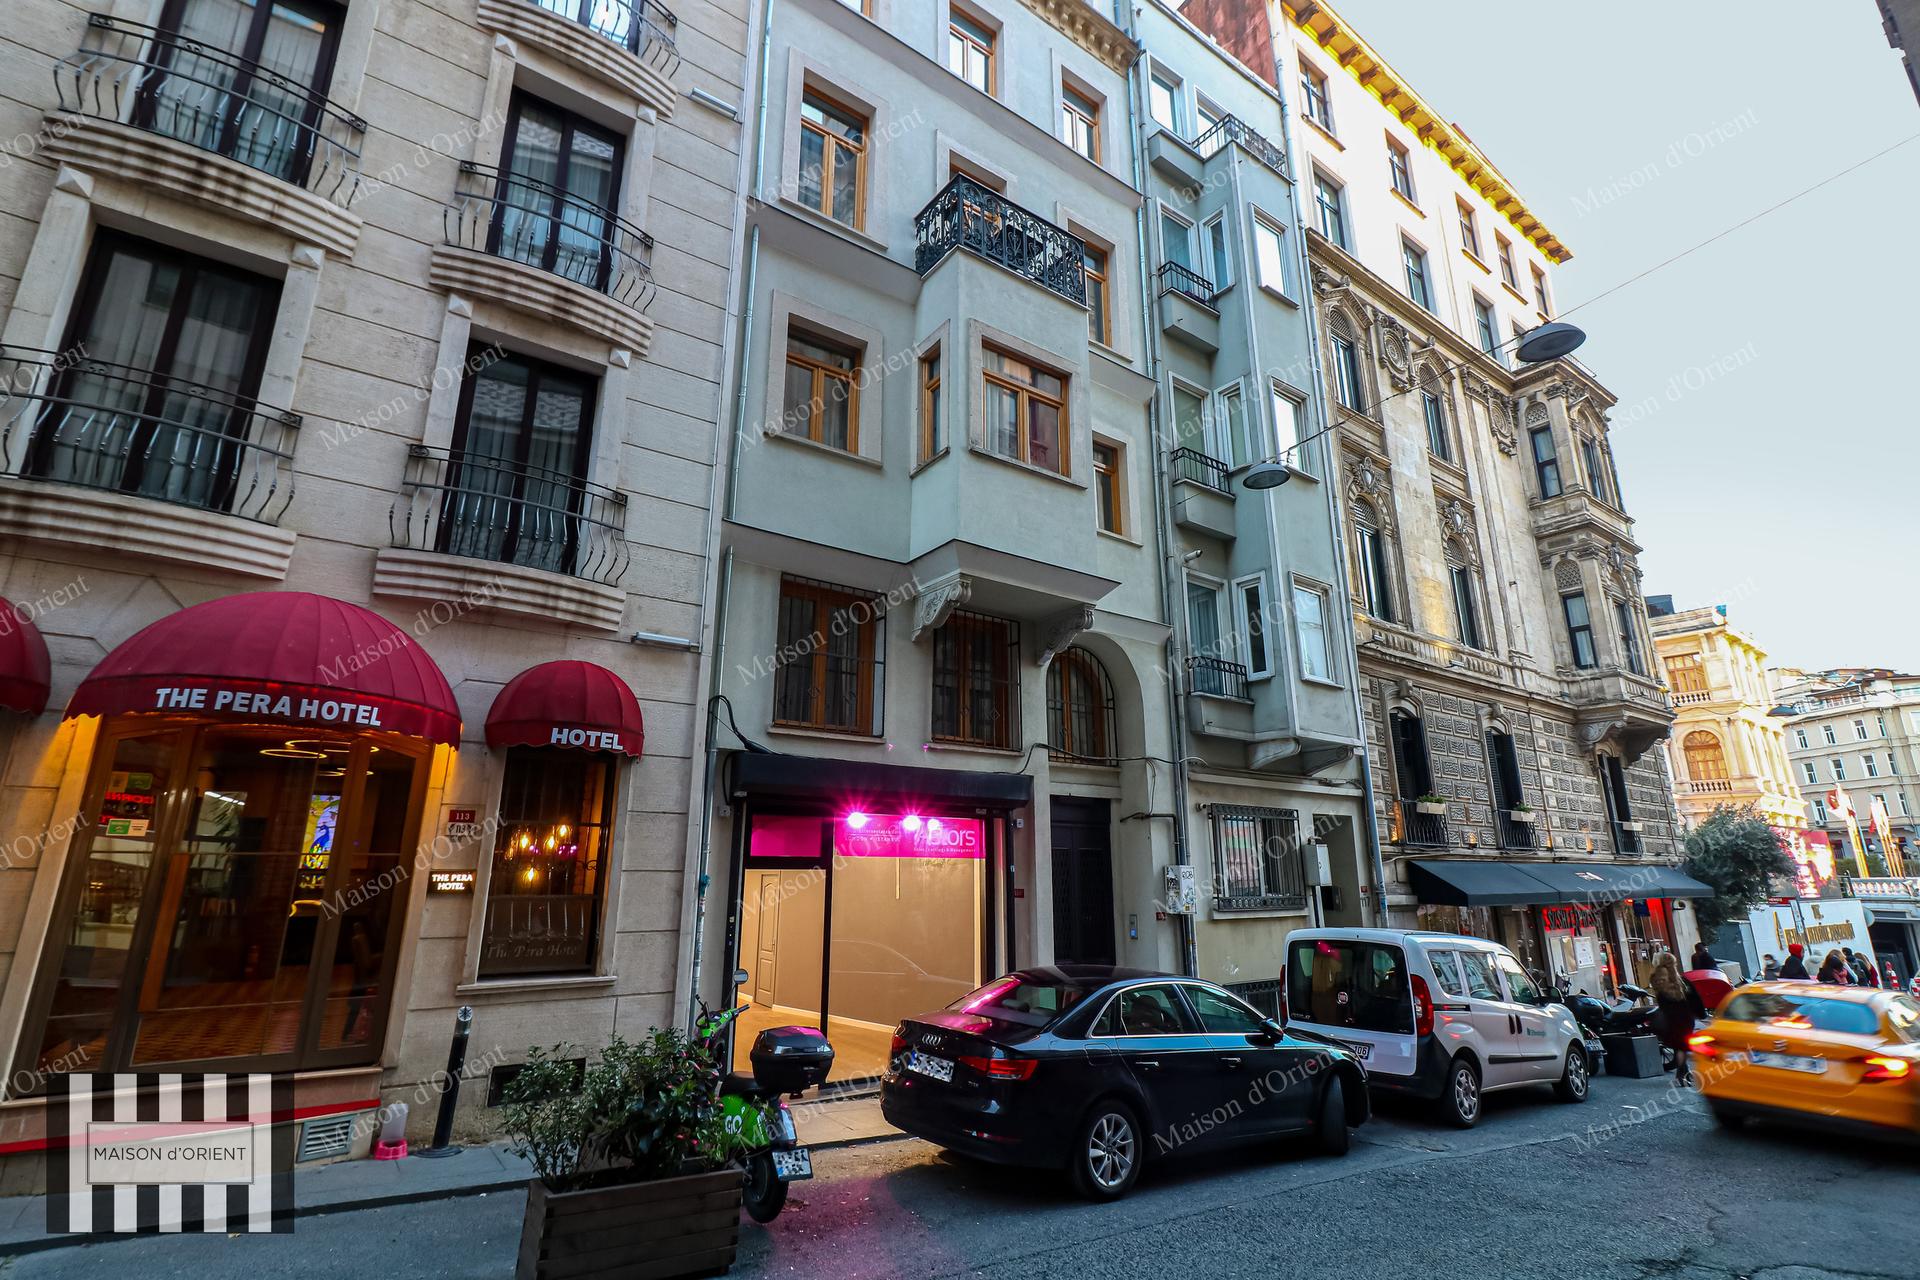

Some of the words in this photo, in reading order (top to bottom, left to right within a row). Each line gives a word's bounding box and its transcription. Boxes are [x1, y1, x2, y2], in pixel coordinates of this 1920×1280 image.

[156, 688, 207, 710] THE
[214, 691, 291, 717] PERA
[300, 699, 381, 727] HOTEL
[551, 727, 623, 751] HOTEL
[432, 874, 449, 882] THE
[451, 874, 473, 882] PERA
[437, 882, 465, 890] HOTEL
